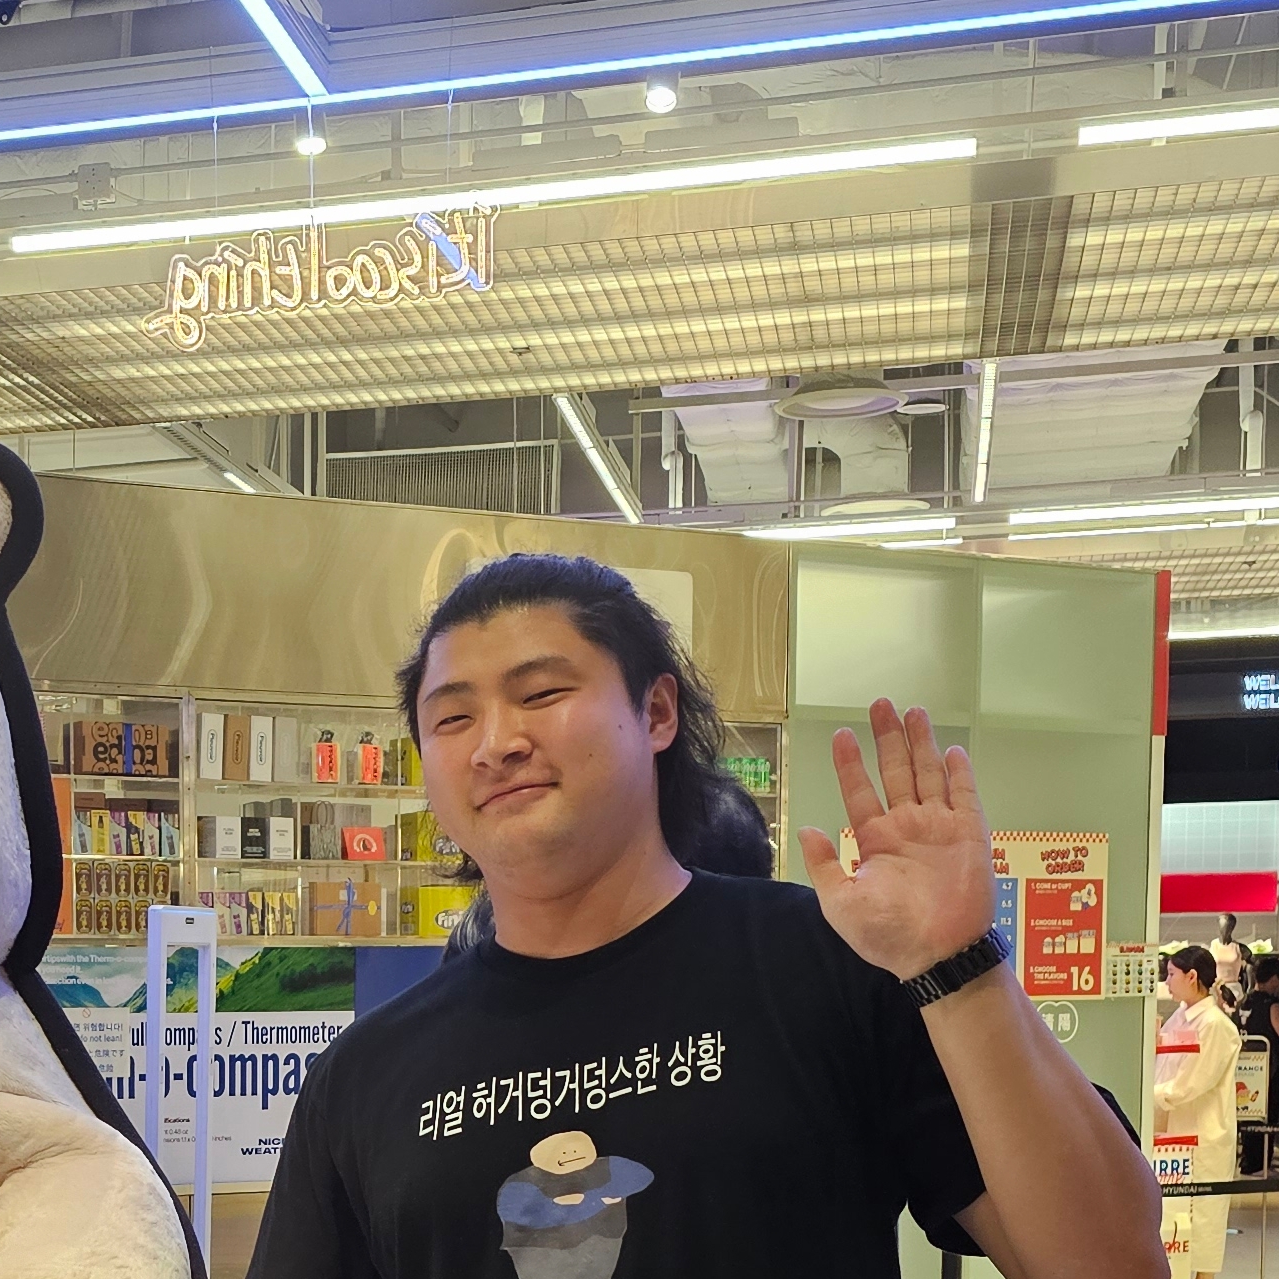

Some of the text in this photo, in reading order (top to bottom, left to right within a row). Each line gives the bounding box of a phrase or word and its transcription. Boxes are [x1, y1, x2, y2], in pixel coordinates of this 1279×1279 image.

[1243, 674, 1279, 690] WEL
[1243, 693, 1279, 710] WEL
[1041, 846, 1088, 861] HOW TO
[1045, 859, 1084, 875] ORDER
[1070, 966, 1094, 991] 16
[241, 1020, 343, 1046] Thermometer
[418, 1030, 727, 1140] 리얼 허거덩거덩스한 상황
[258, 1138, 285, 1146] NIC
[240, 1147, 281, 1156] WEAT
[1162, 1185, 1197, 1194] HYUNDAI
[1163, 1240, 1189, 1254] RRE
